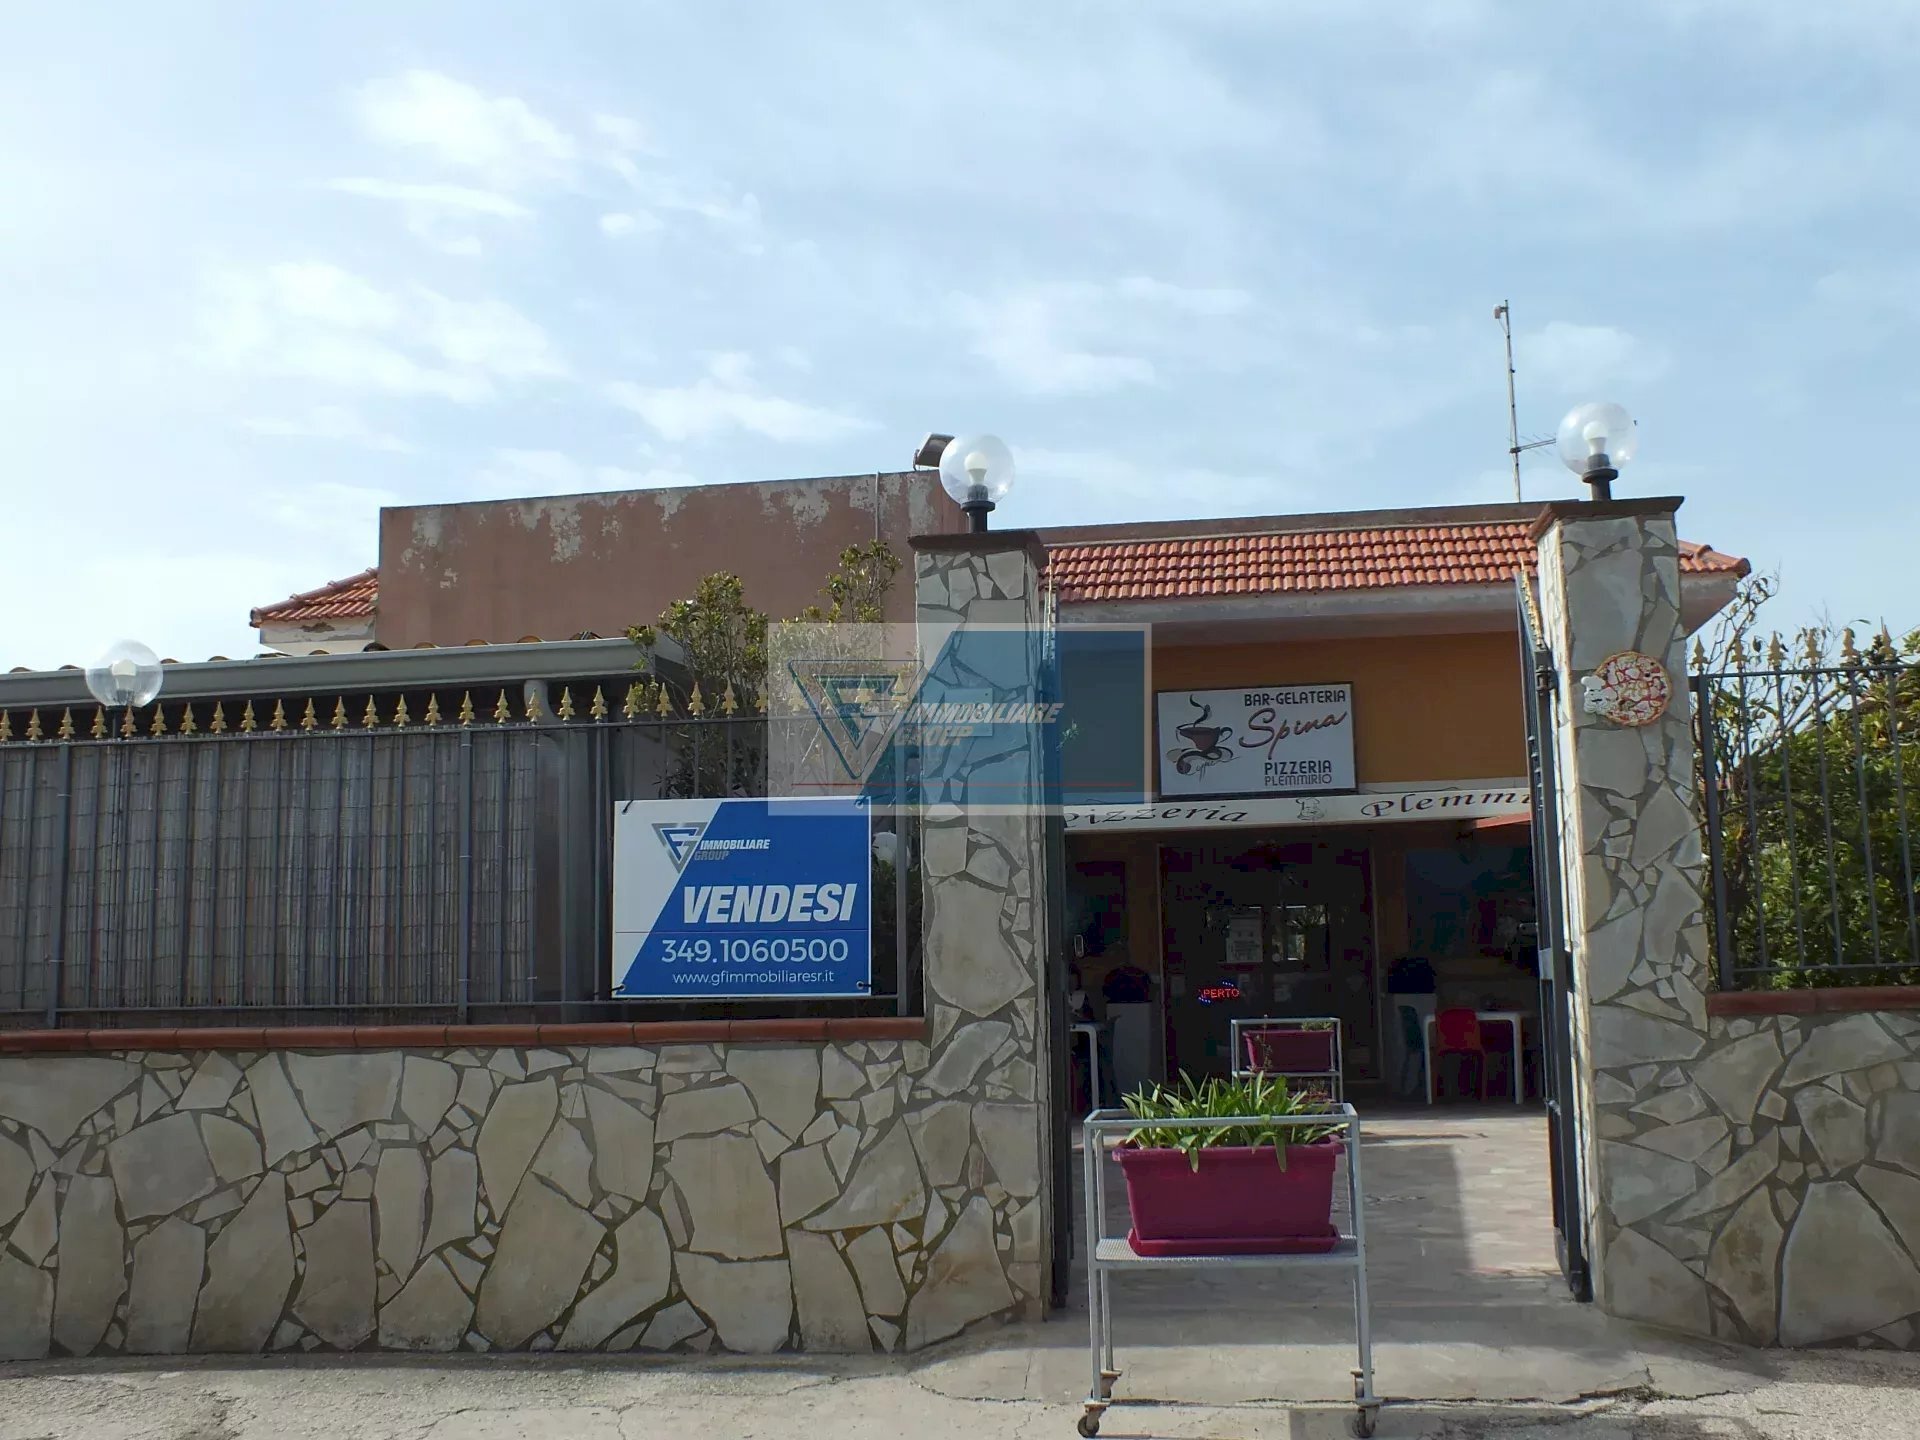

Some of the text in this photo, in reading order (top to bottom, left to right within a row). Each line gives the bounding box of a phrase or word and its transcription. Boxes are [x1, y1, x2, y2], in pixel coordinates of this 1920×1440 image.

[1244, 689, 1346, 707] BAR-GELATERIA
[1238, 707, 1348, 760] Spina
[1264, 760, 1332, 775] PIZZERIA
[1264, 774, 1332, 787] PLEMMIRIO
[699, 839, 771, 851] IMMOBILIARE
[694, 850, 729, 861] GROUP
[683, 883, 858, 924] VENDESI
[661, 938, 849, 963] 349.1060500
[672, 970, 835, 986] www.gfimmobiliaresr.it
